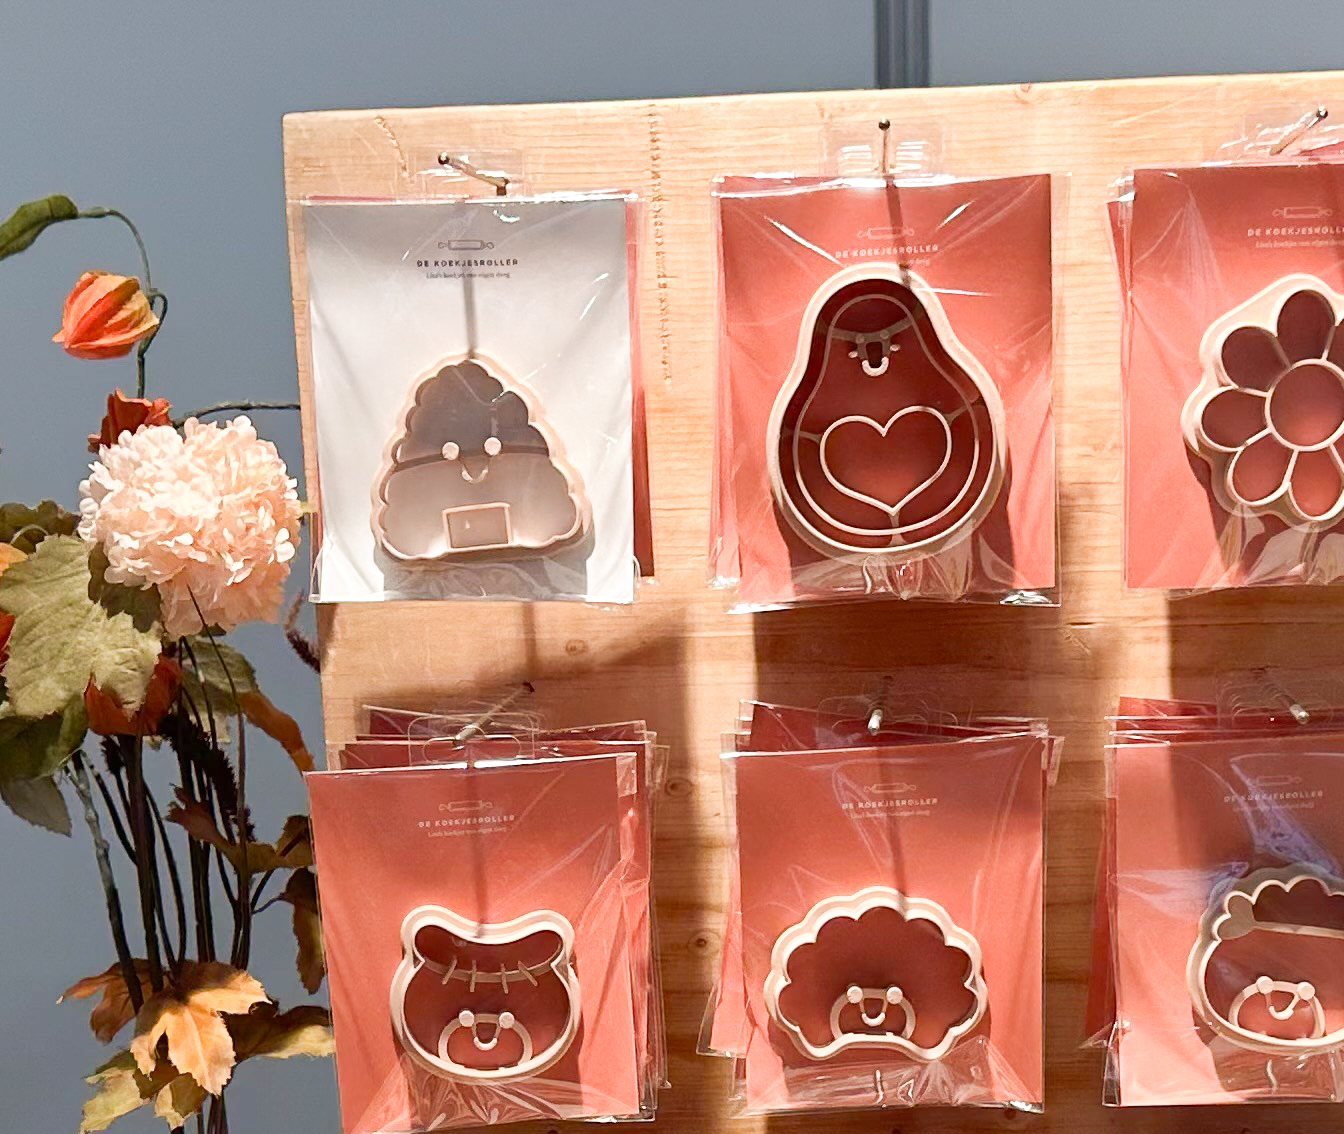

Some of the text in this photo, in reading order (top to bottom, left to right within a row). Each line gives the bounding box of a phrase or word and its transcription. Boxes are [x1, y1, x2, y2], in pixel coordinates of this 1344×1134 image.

[1247, 228, 1261, 237] DE
[835, 249, 849, 259] DE
[416, 258, 519, 267] DE KOEKJESROLLER
[418, 820, 431, 828] DE
